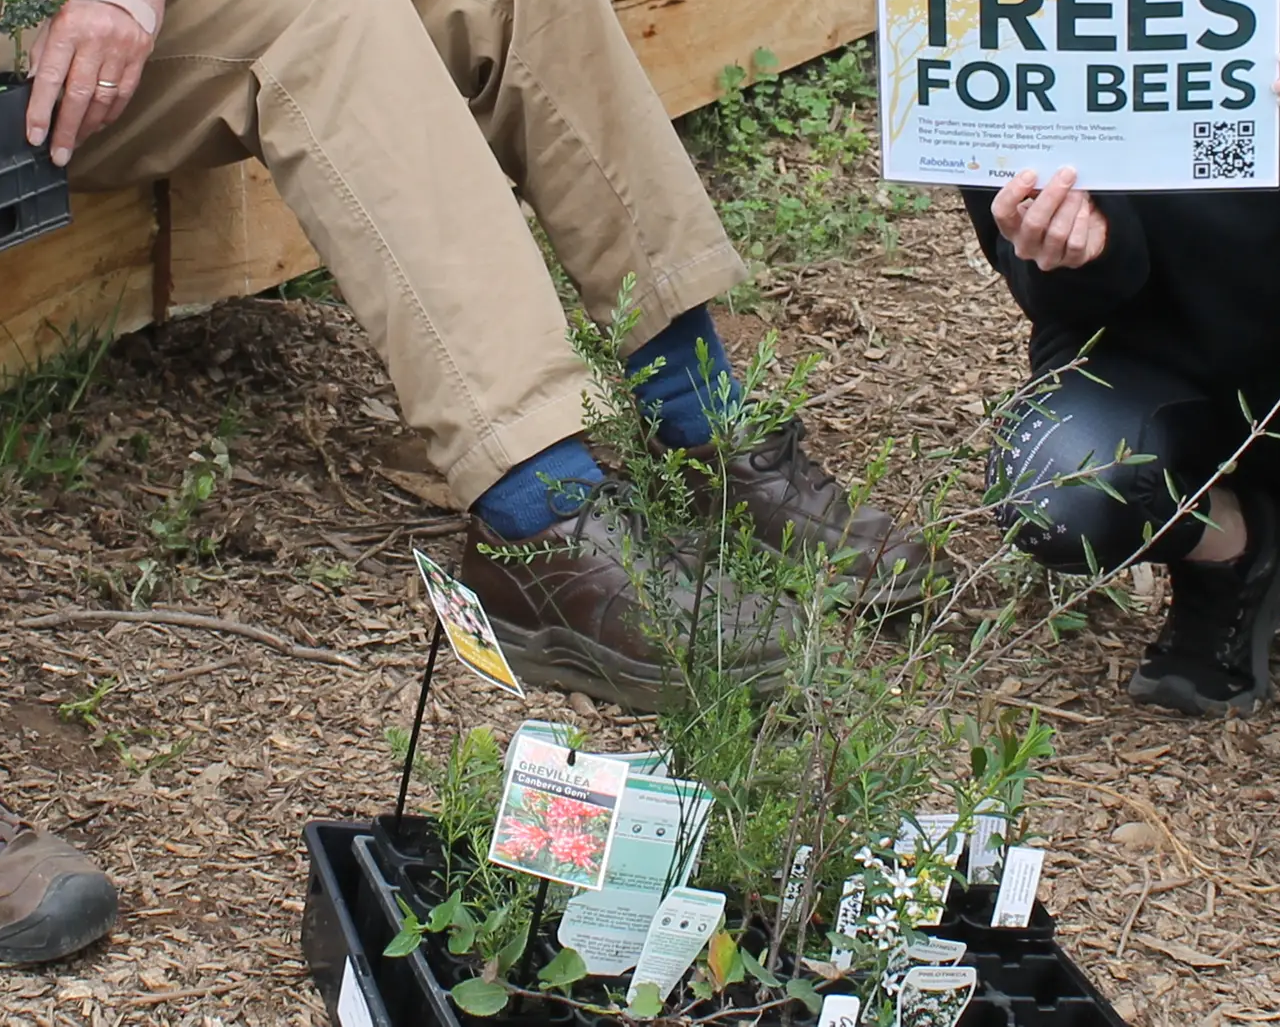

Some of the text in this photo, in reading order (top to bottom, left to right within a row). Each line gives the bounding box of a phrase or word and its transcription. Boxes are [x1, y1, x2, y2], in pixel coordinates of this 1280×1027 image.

[917, 58, 1256, 112] FOR BEES
[918, 117, 933, 125] This
[935, 119, 959, 127] garden
[1025, 124, 1054, 132] support
[934, 128, 980, 137] Foundation's
[1036, 133, 1079, 142] Community
[972, 141, 999, 149] proudly
[1001, 143, 1040, 151] supported
[919, 156, 965, 168] Rabobank
[989, 169, 1016, 178] FLOW
[519, 761, 591, 788] GREVILLEA
[516, 772, 591, 800] 'Canberra Gem'
